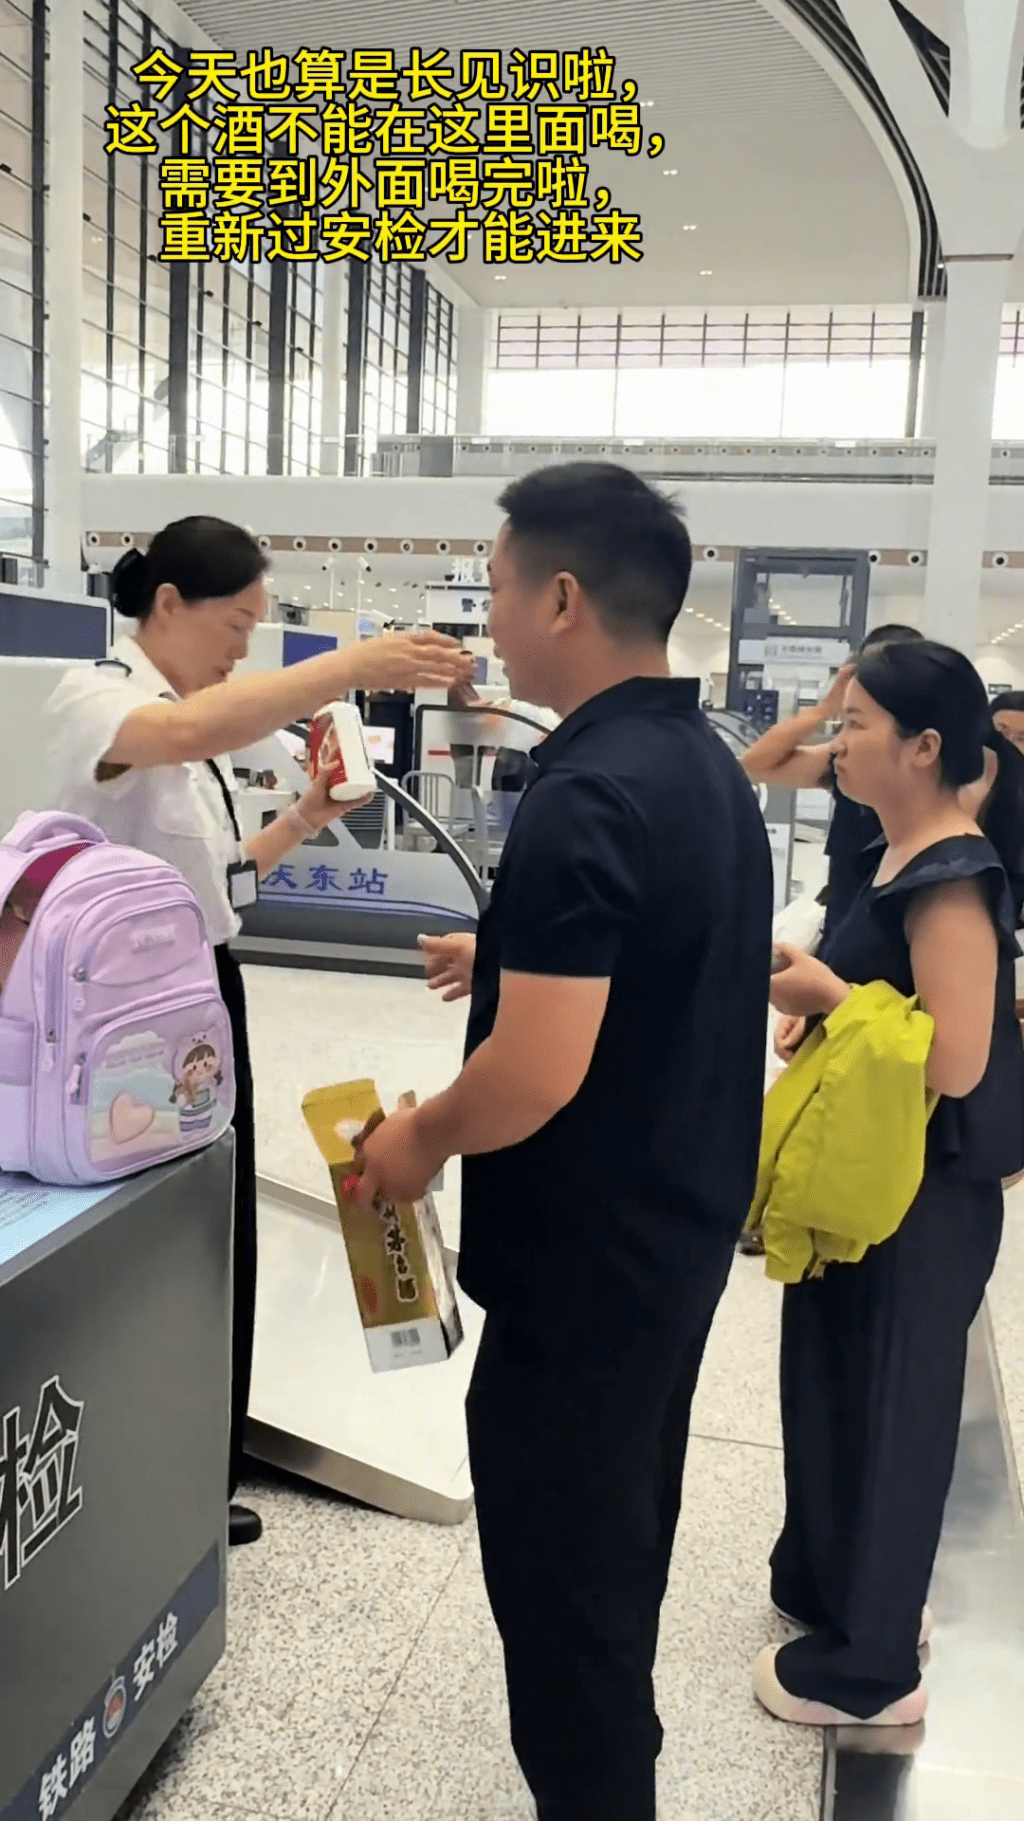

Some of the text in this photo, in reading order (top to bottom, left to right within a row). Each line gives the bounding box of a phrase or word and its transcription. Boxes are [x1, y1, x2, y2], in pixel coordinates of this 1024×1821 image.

[0, 1375, 84, 1590] 检
[39, 1612, 178, 1821] 铁路 安检
